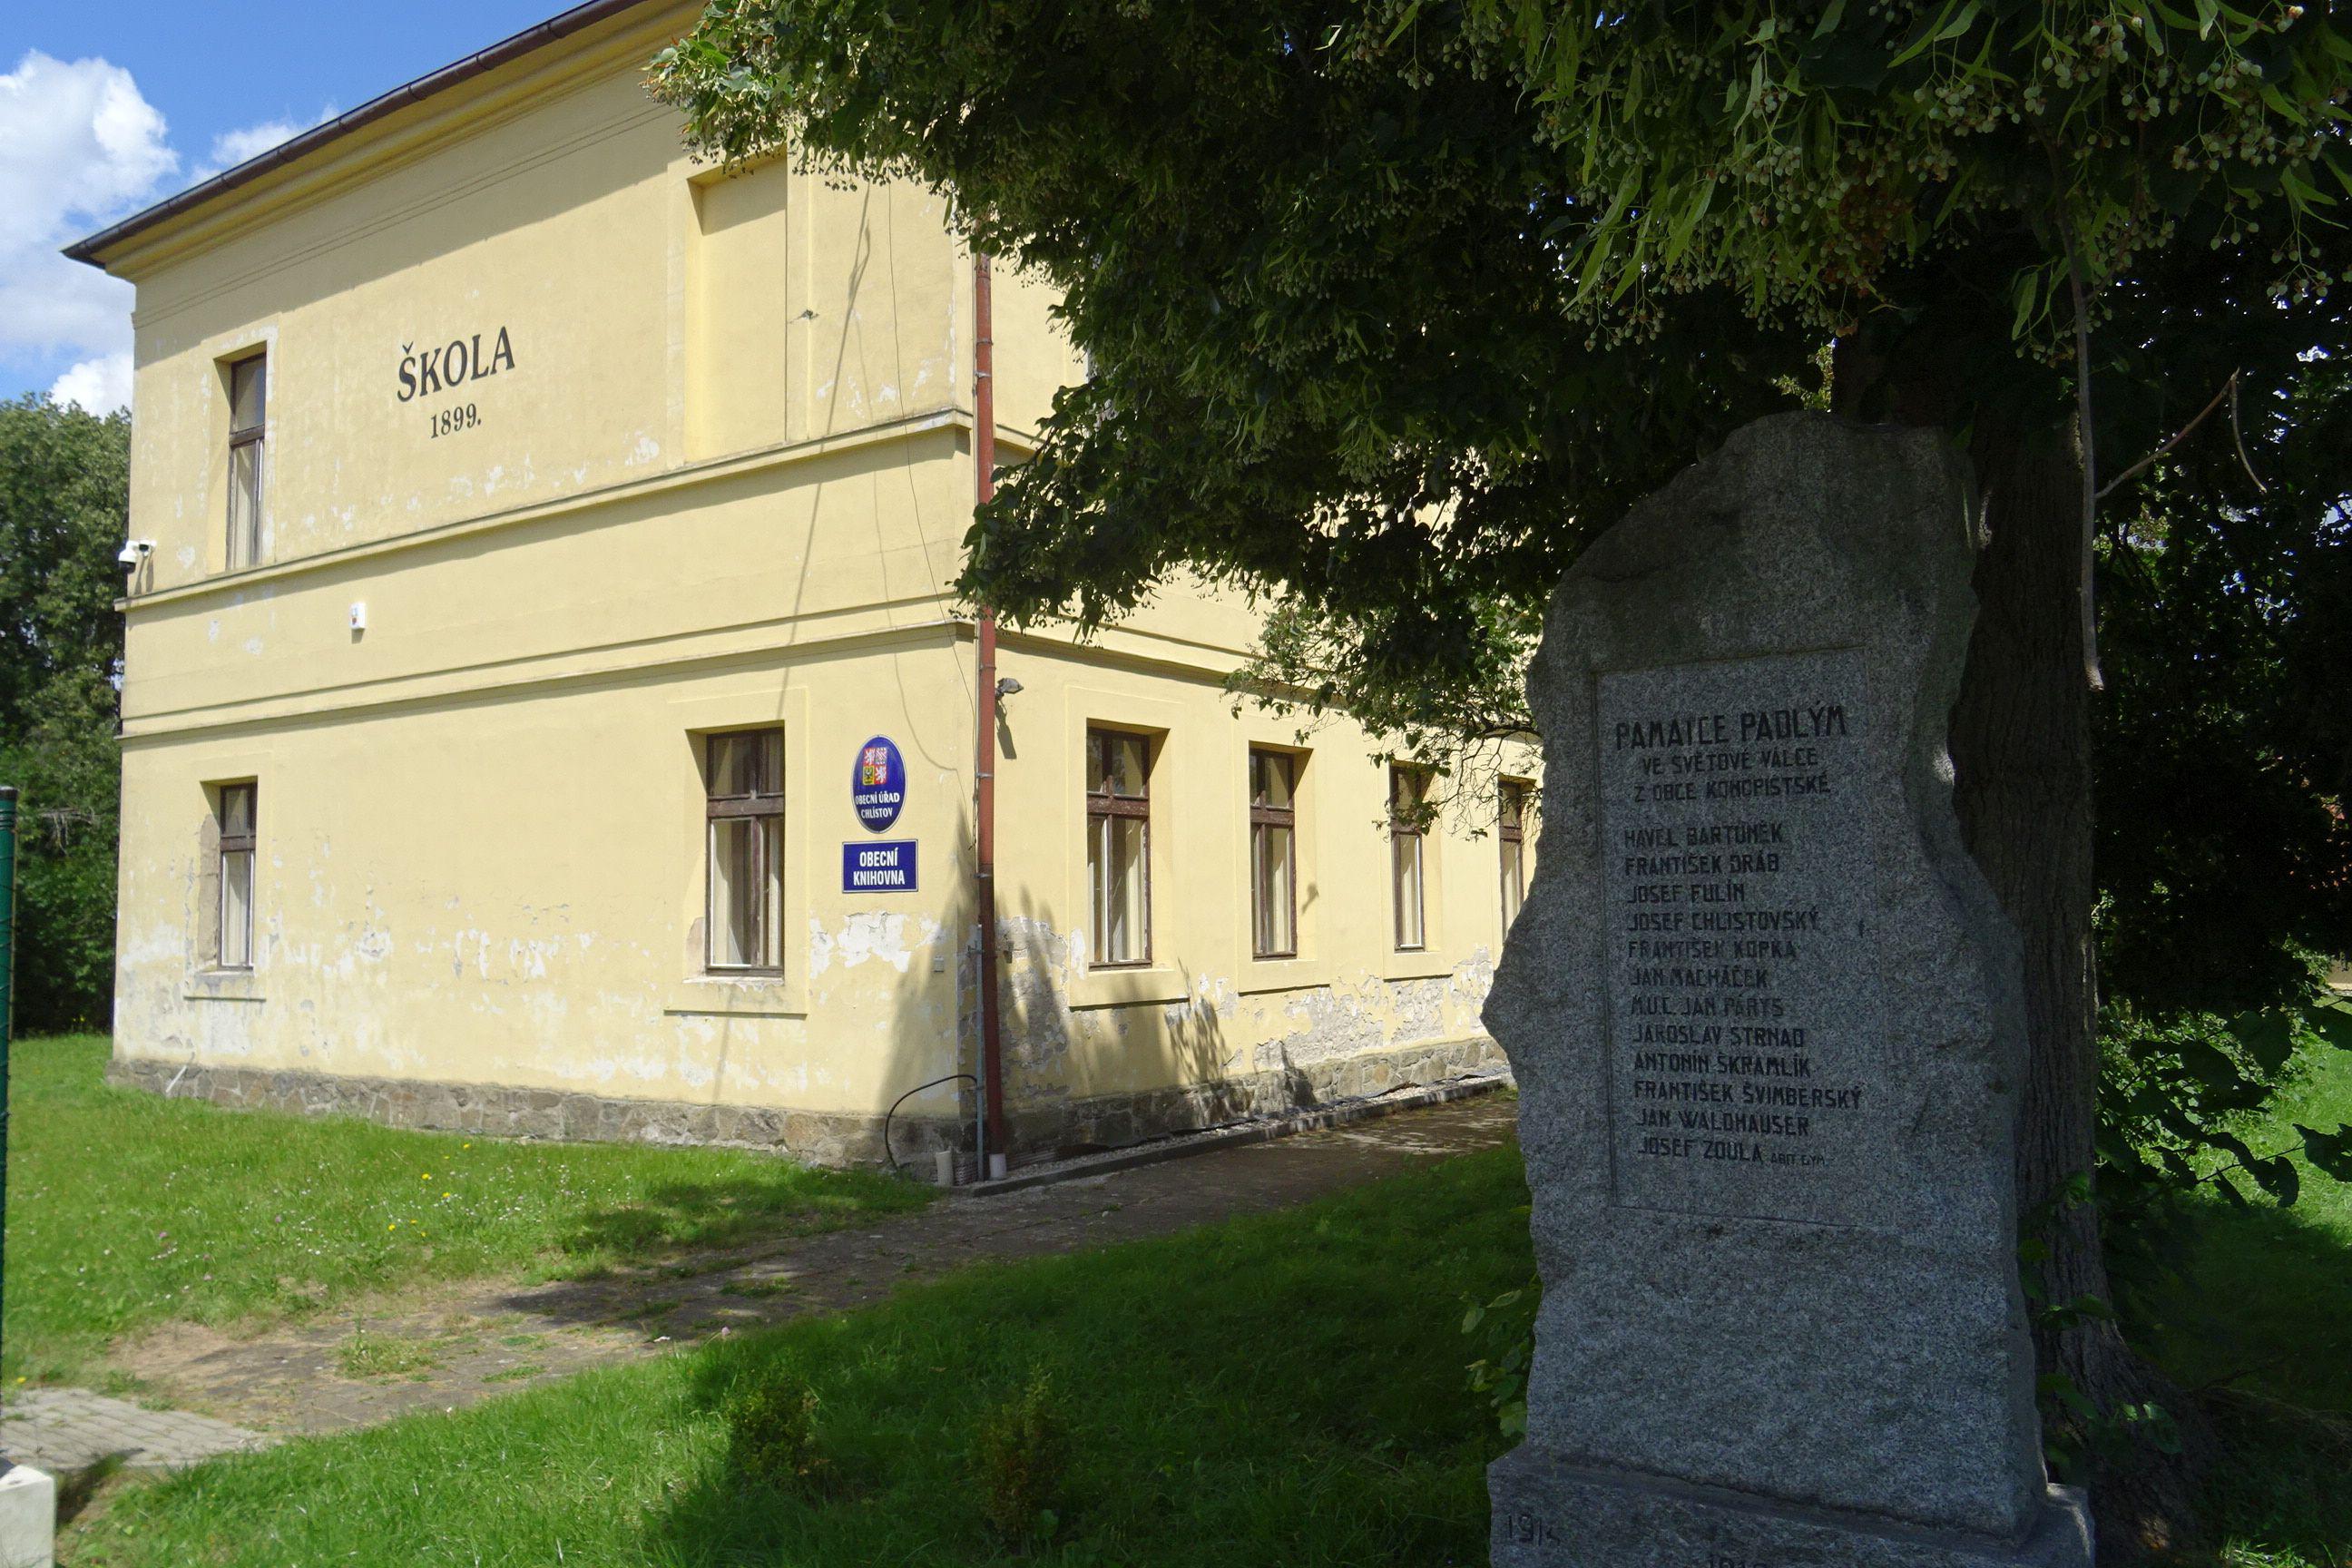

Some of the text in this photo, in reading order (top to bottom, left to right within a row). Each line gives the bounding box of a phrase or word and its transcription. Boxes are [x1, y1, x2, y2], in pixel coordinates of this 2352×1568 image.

[397, 326, 514, 402] ŠKOLA
[431, 403, 482, 438] 1899.
[1740, 700, 1847, 742] PADLÝM
[1642, 747, 1818, 775] VE SVĚTOVÉ VÁLCE
[856, 790, 900, 805] OBECNÍ ÚŘAD
[1634, 785, 1646, 803] Z
[1652, 782, 1697, 801] OBCE
[861, 806, 893, 818] CHLÍSTOV
[1625, 828, 1680, 848] HAVEL
[859, 847, 898, 867] OBECNÍ
[1625, 849, 1779, 876] FRANTIŠEK DRÁB
[853, 870, 905, 886] KNIHOVNA
[1627, 878, 1745, 904] JOSEF FULÍN
[1627, 912, 1685, 932] JOSEF
[1734, 940, 1797, 958] KOPKA
[1632, 965, 1769, 987] JAN MACHÁČEK
[1681, 996, 1716, 1015] JAN
[1632, 1024, 1805, 1048] JAROSLAV STRNAD
[1635, 1050, 1811, 1078] ANTONÍN ŠKRAMLÍK
[1634, 1080, 1734, 1102] FRANTIŠEK
[1636, 1108, 1809, 1136] JAN WALDHAUSER
[1637, 1137, 1699, 1157] JOSEF
[1703, 1140, 1764, 1162] ZOULA
